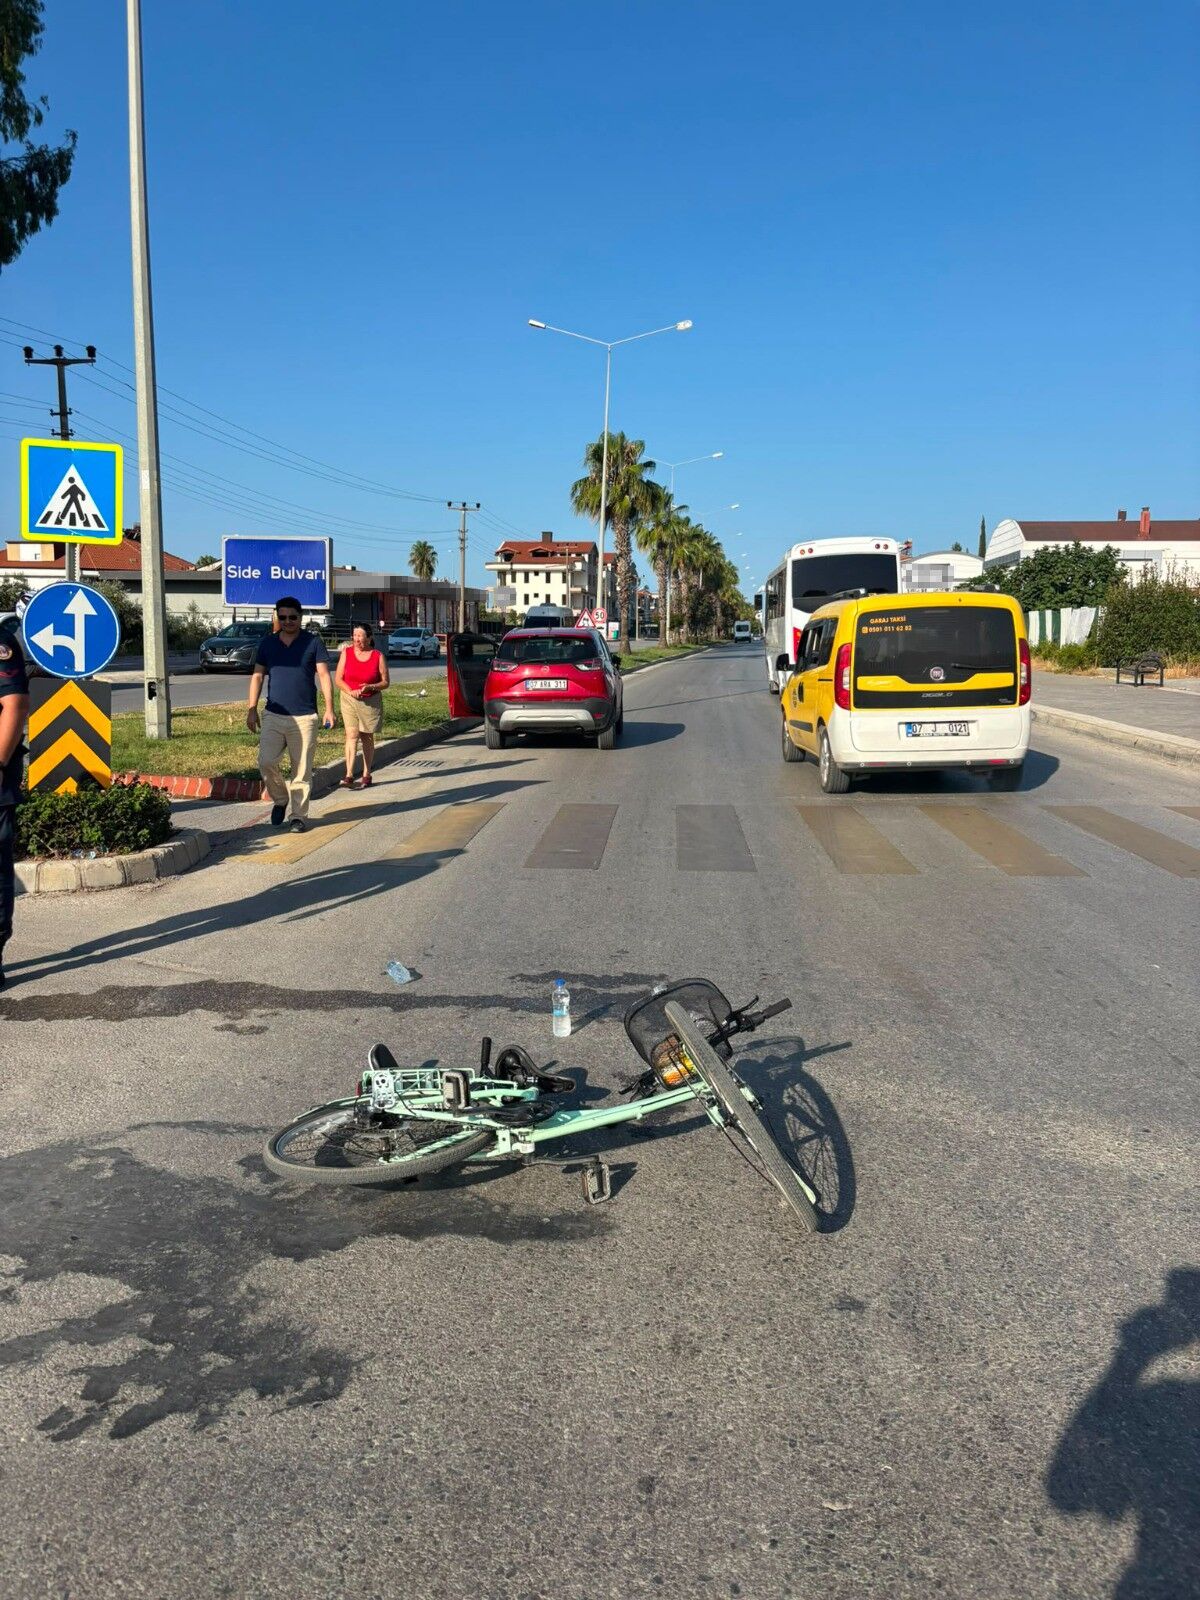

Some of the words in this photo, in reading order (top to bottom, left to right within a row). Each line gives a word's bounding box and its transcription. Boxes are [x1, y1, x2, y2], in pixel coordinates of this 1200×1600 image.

[227, 565, 261, 579] Side
[270, 565, 325, 580] Bulvarı
[595, 611, 605, 620] 50
[540, 680, 551, 688] ARA
[554, 680, 566, 688] 311
[912, 723, 923, 734] 07
[931, 723, 937, 733] J
[948, 722, 967, 733] 0121
